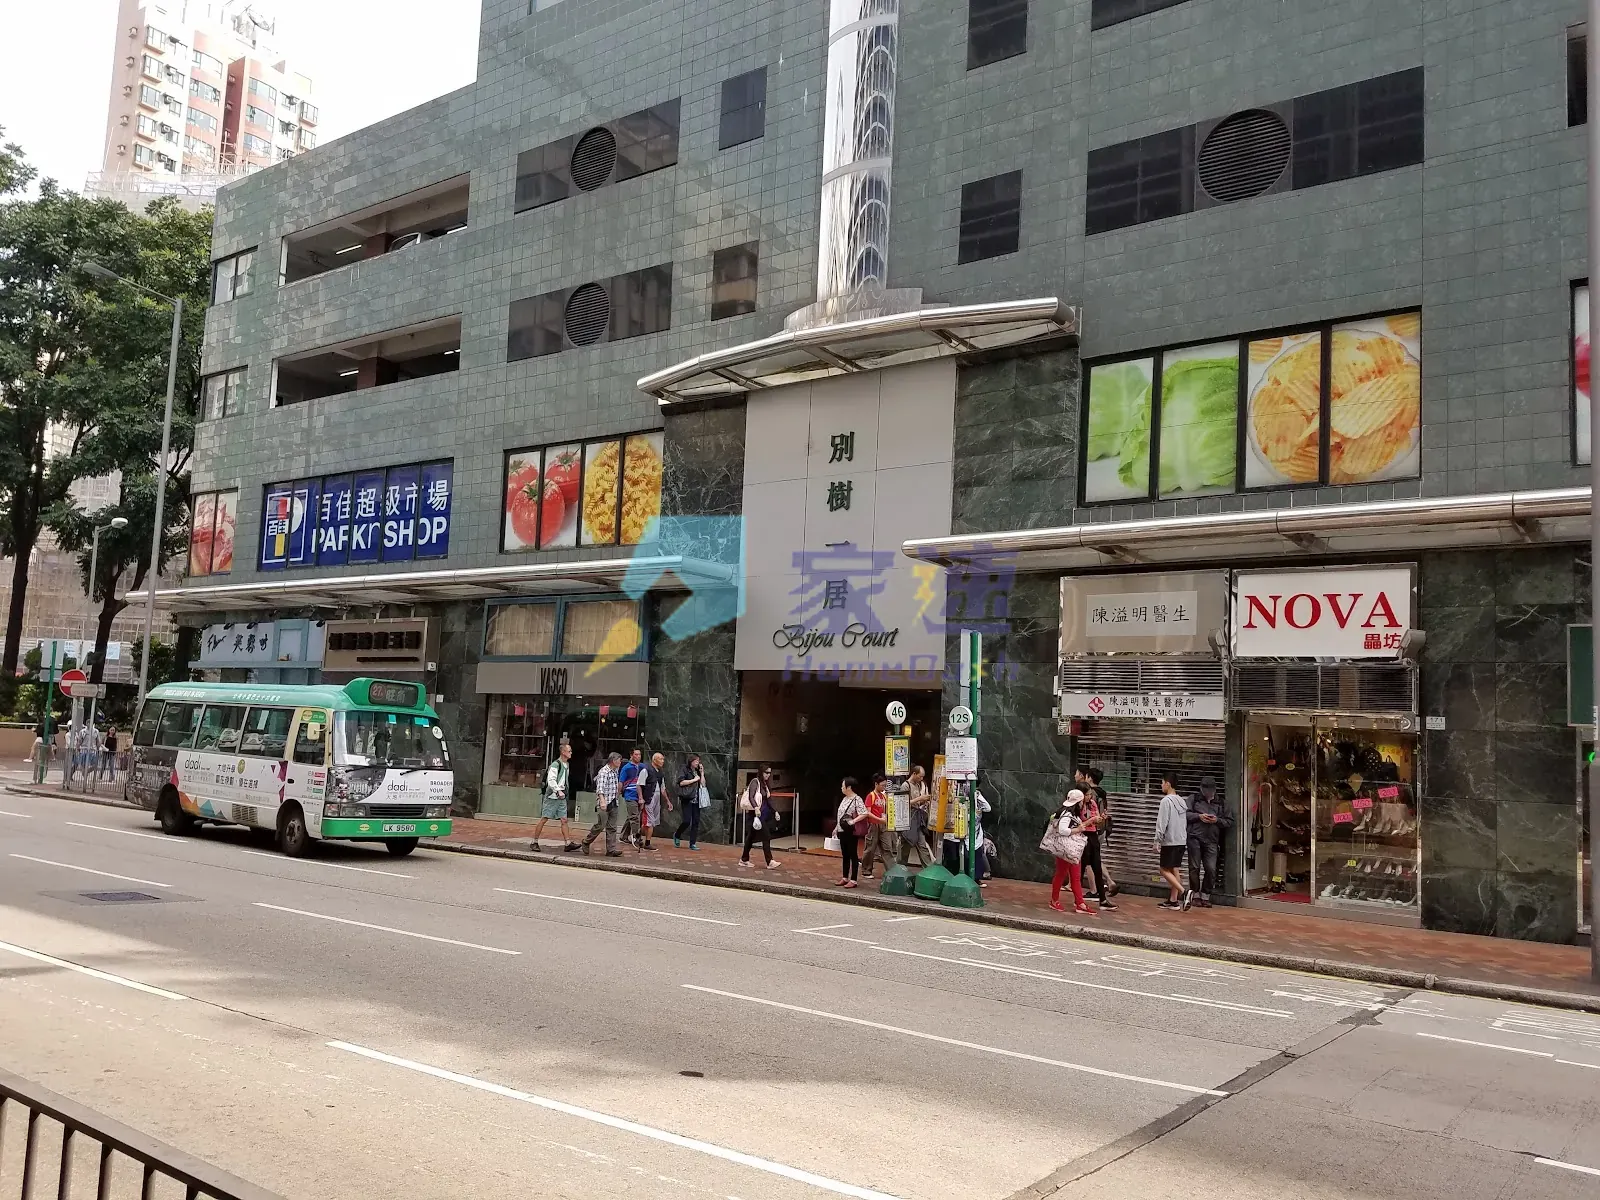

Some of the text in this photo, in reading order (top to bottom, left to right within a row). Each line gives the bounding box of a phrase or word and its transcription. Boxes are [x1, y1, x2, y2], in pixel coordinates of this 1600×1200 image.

[822, 431, 855, 610] 別樹一居
[1092, 604, 1190, 624] 陳溢明醫生
[1243, 591, 1402, 629] NOVA
[772, 622, 899, 657] Bijou Court
[541, 667, 568, 695] VASCO
[1109, 695, 1196, 708] 陳溢明醫生醫務所
[892, 706, 904, 718] 46
[951, 713, 969, 724] 12S
[387, 780, 407, 791] dadi
[384, 824, 393, 832] LK
